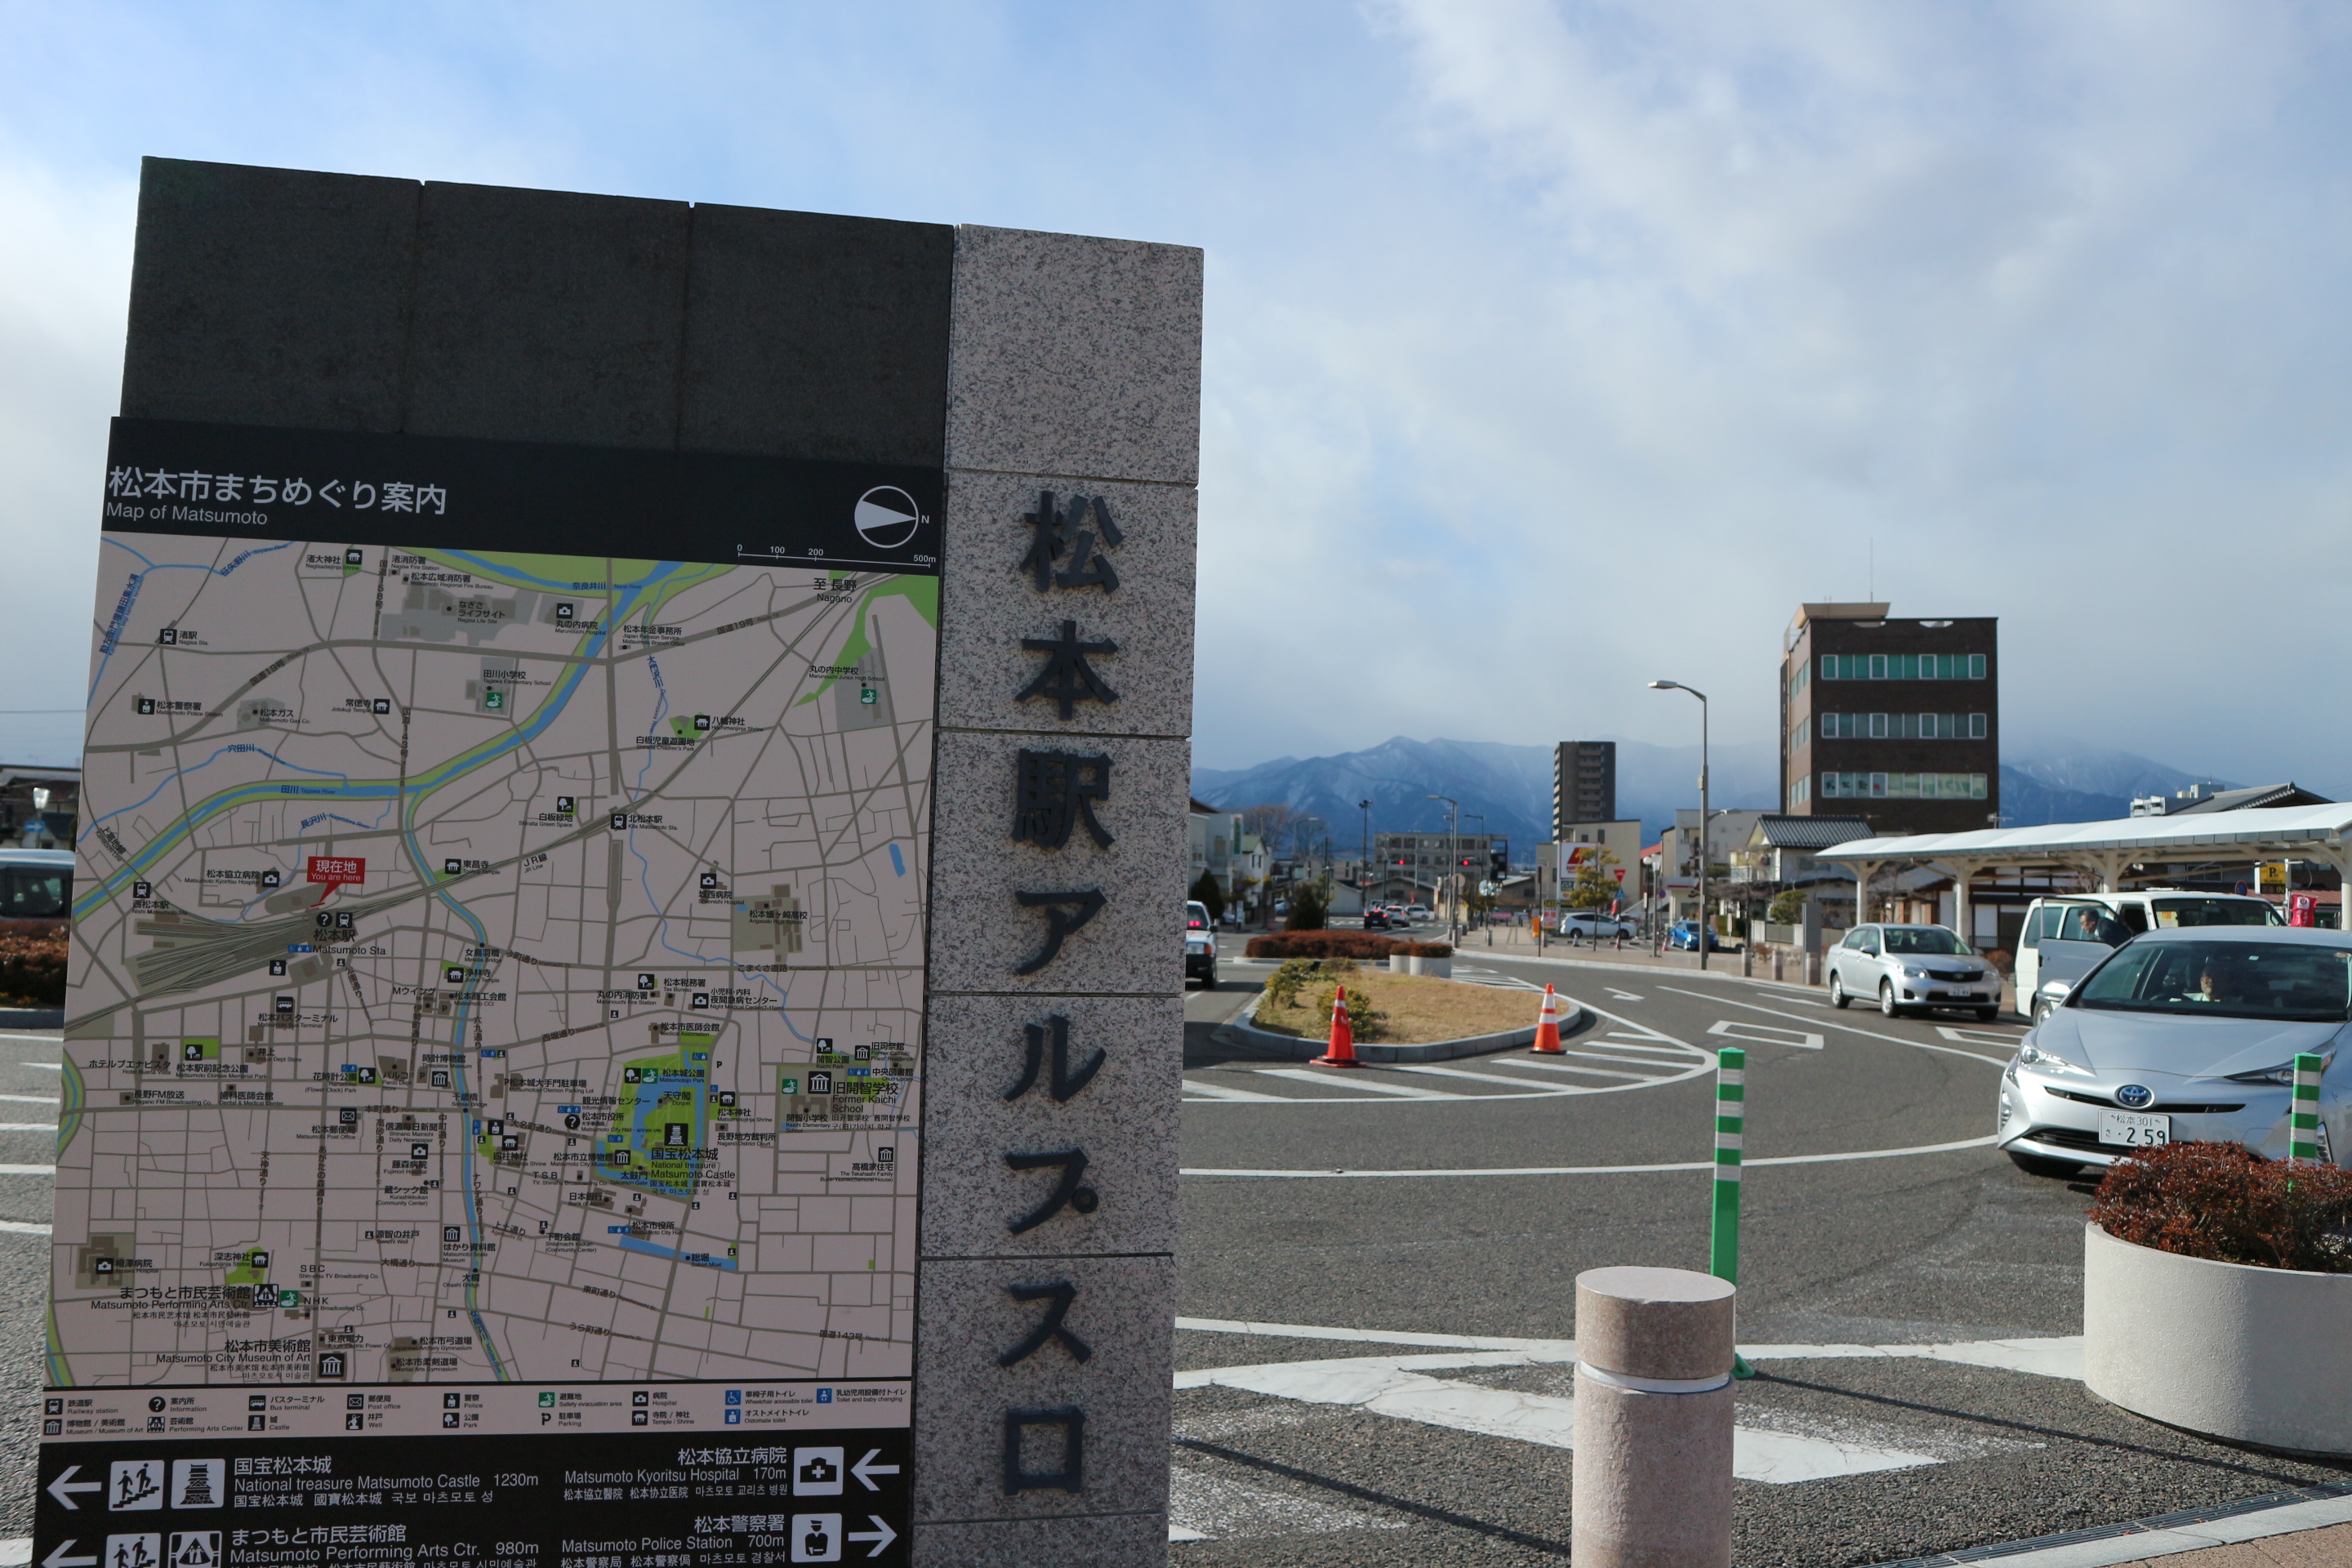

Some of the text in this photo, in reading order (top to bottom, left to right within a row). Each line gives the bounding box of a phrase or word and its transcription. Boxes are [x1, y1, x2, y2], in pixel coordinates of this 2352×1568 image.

[108, 466, 447, 515] 松本市まちめぐり案内
[107, 502, 268, 525] Map of Matsumoto
[921, 515, 929, 523] N
[737, 544, 742, 552] 0
[808, 548, 823, 556] 200
[913, 555, 936, 564] 500m
[411, 572, 471, 582] 松本広域消防署
[813, 578, 857, 592] 至 長野
[817, 593, 853, 604] Nagano
[458, 601, 483, 609] なぎさ
[458, 610, 506, 619] ライフサイト
[555, 621, 598, 630] 丸の内病院
[623, 625, 682, 635] 松本年金事務所
[483, 670, 527, 679] 田川小学校
[809, 666, 859, 675] 丸の内中学校
[156, 701, 202, 711] 松本警察署
[260, 708, 294, 717] 松本ガス
[636, 736, 695, 746] 白板児童遊園地
[628, 814, 662, 823] 北松本駅
[316, 860, 357, 873] 現在地
[206, 869, 261, 880] 松本協立病院
[314, 929, 355, 943] 松本駅
[313, 945, 367, 956] Matsumoto
[737, 964, 787, 973] こまくさ道路
[663, 978, 706, 987] 松本税務署
[453, 991, 506, 1001] 松本商工会館
[597, 990, 648, 1000] 丸の内消防署
[997, 490, 1125, 1496] 松本駅アルプス口
[710, 996, 777, 1005] 夜間急病センター
[661, 1022, 719, 1032] 松本市医師会館
[421, 1054, 466, 1063] 時計博物館
[89, 1060, 171, 1068] ホテルブエナビスタ
[176, 1064, 248, 1073] 松本駅前記念公園
[833, 1081, 898, 1095] 旧開智学校
[582, 1097, 650, 1105] 観光情報センター
[832, 1094, 896, 1103] Former Kaichi
[832, 1104, 863, 1113] School
[311, 1125, 356, 1134] 松本郵便局
[651, 1147, 719, 1160] 国宝松本城
[651, 1160, 679, 1169] National
[852, 1162, 893, 1171] 高橋家住宅
[651, 1169, 736, 1179] Matsumoto Castle
[120, 1285, 251, 1300] まつもと市民芸術館
[91, 1300, 148, 1309] Matsumoto
[152, 1300, 208, 1310] Performing
[211, 1300, 230, 1308] Arts
[304, 1297, 329, 1305] NHK
[419, 1336, 472, 1345] 松本市弓道場
[224, 1339, 311, 1353] 松本市美術館
[156, 1353, 311, 1363] Matsumoto City Museum of Art
[559, 1392, 582, 1401] 避難地
[653, 1392, 668, 1400] 病院
[745, 1390, 795, 1398] 車椅子用トイレ
[836, 1388, 906, 1396] 乳幼児用設備付トイレ
[171, 1397, 195, 1405] 案内所
[270, 1396, 324, 1404] バスターミナル
[368, 1395, 391, 1403] 郵便局
[464, 1394, 479, 1402] 警察
[68, 1399, 93, 1407] 鉄道駅
[368, 1413, 383, 1421] 井戸
[559, 1412, 581, 1420] 駐車場
[653, 1410, 690, 1419] 寺院 神社
[745, 1409, 809, 1417] オストメイトトイレ
[170, 1417, 194, 1425] 芸術館
[270, 1415, 278, 1423] 城
[463, 1414, 479, 1422] 公園
[67, 1418, 126, 1428] 博物館 美術館
[678, 1446, 787, 1466] 松本協立病院
[234, 1455, 332, 1476] 国宝松本城
[565, 1468, 786, 1486] Matsumoto Kyoritsu Hospital 170m
[234, 1473, 539, 1493] National treasure Matsumoto Castle 1230m
[630, 1486, 688, 1499] 松本协立医院
[695, 1486, 733, 1497] 마츠모토
[737, 1485, 765, 1496] 교리츠
[769, 1484, 787, 1495] 병원
[234, 1493, 304, 1508] 国宝松本城
[391, 1492, 417, 1504] 국보
[423, 1491, 476, 1503] 마츠모토
[481, 1490, 493, 1503] 성
[694, 1514, 785, 1534] 松本警察署
[232, 1524, 407, 1546] まつもと市民芸術館
[562, 1535, 784, 1553] Matsumoto Police Station 700m
[230, 1542, 539, 1564] Matsumoto Performing Arts Ctr. 980m
[561, 1556, 621, 1568] 松本警察局
[700, 1552, 746, 1565] 마츠모토
[751, 1552, 786, 1564] 경찰서
